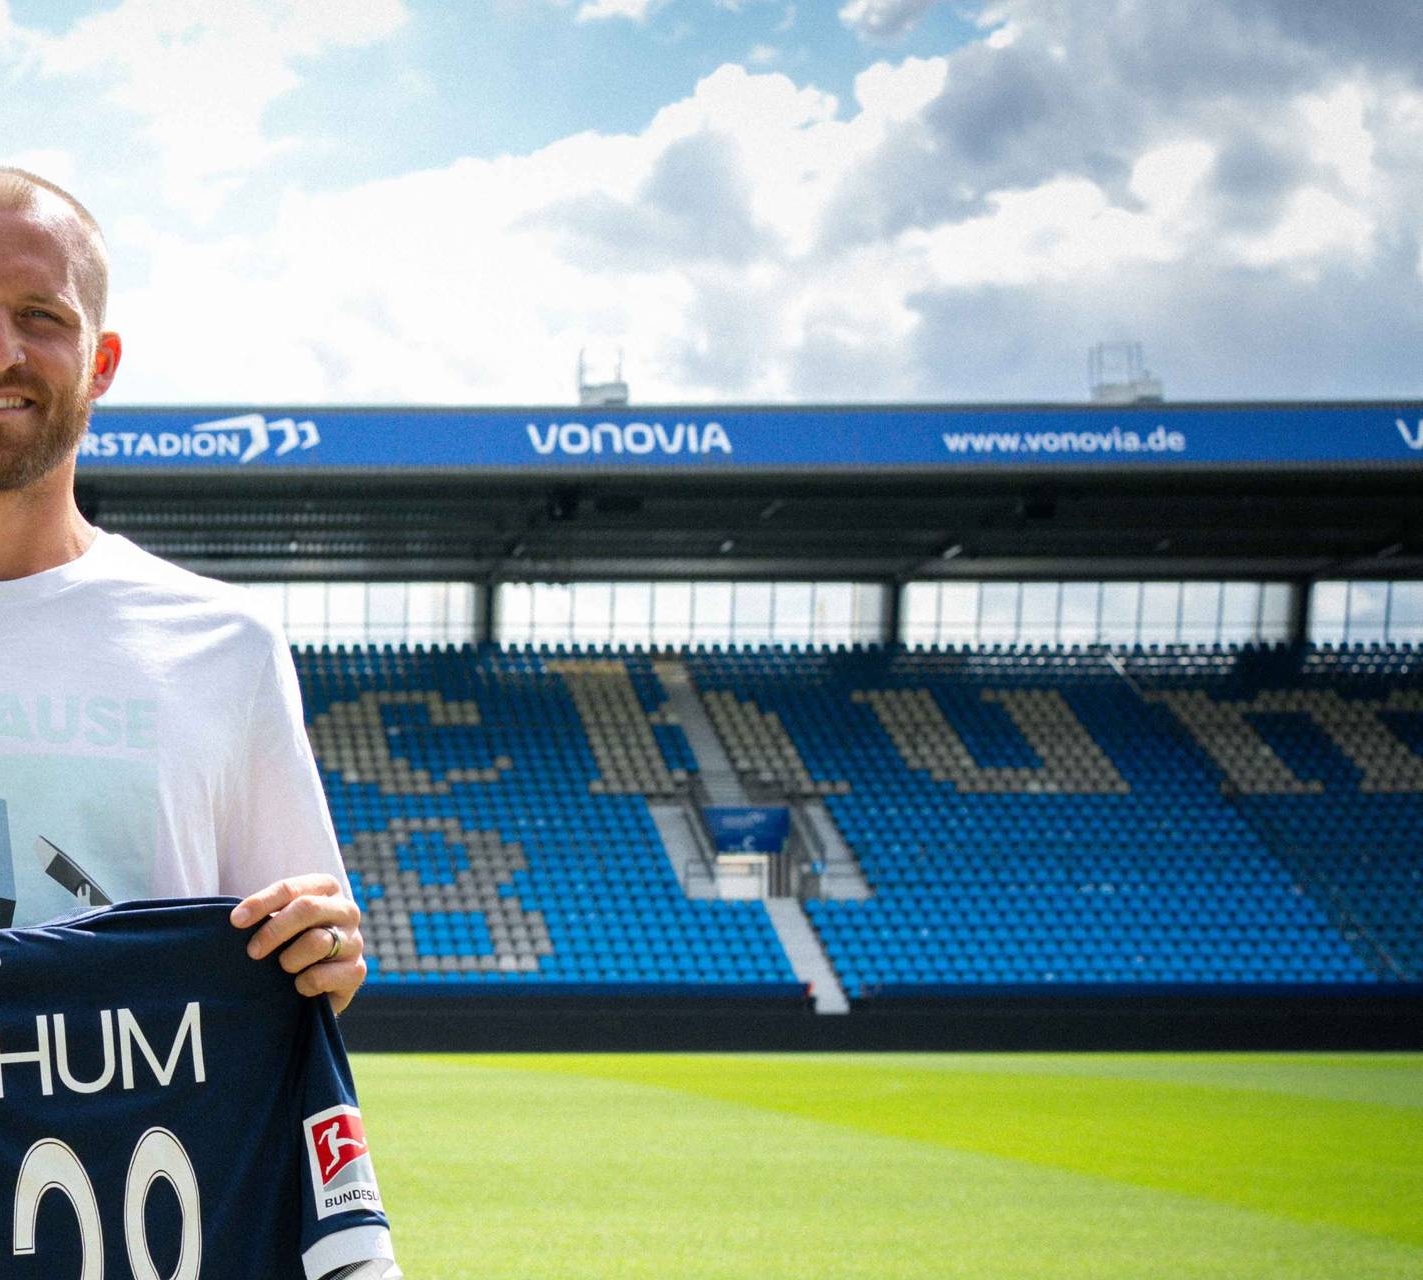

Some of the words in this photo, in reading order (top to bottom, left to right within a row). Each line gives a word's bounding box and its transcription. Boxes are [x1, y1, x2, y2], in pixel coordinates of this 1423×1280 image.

[78, 431, 240, 457] RSTADION
[526, 421, 733, 455] VONOVIA
[942, 425, 1186, 455] www.vonovia.de
[324, 1188, 380, 1208] BUNDESL
